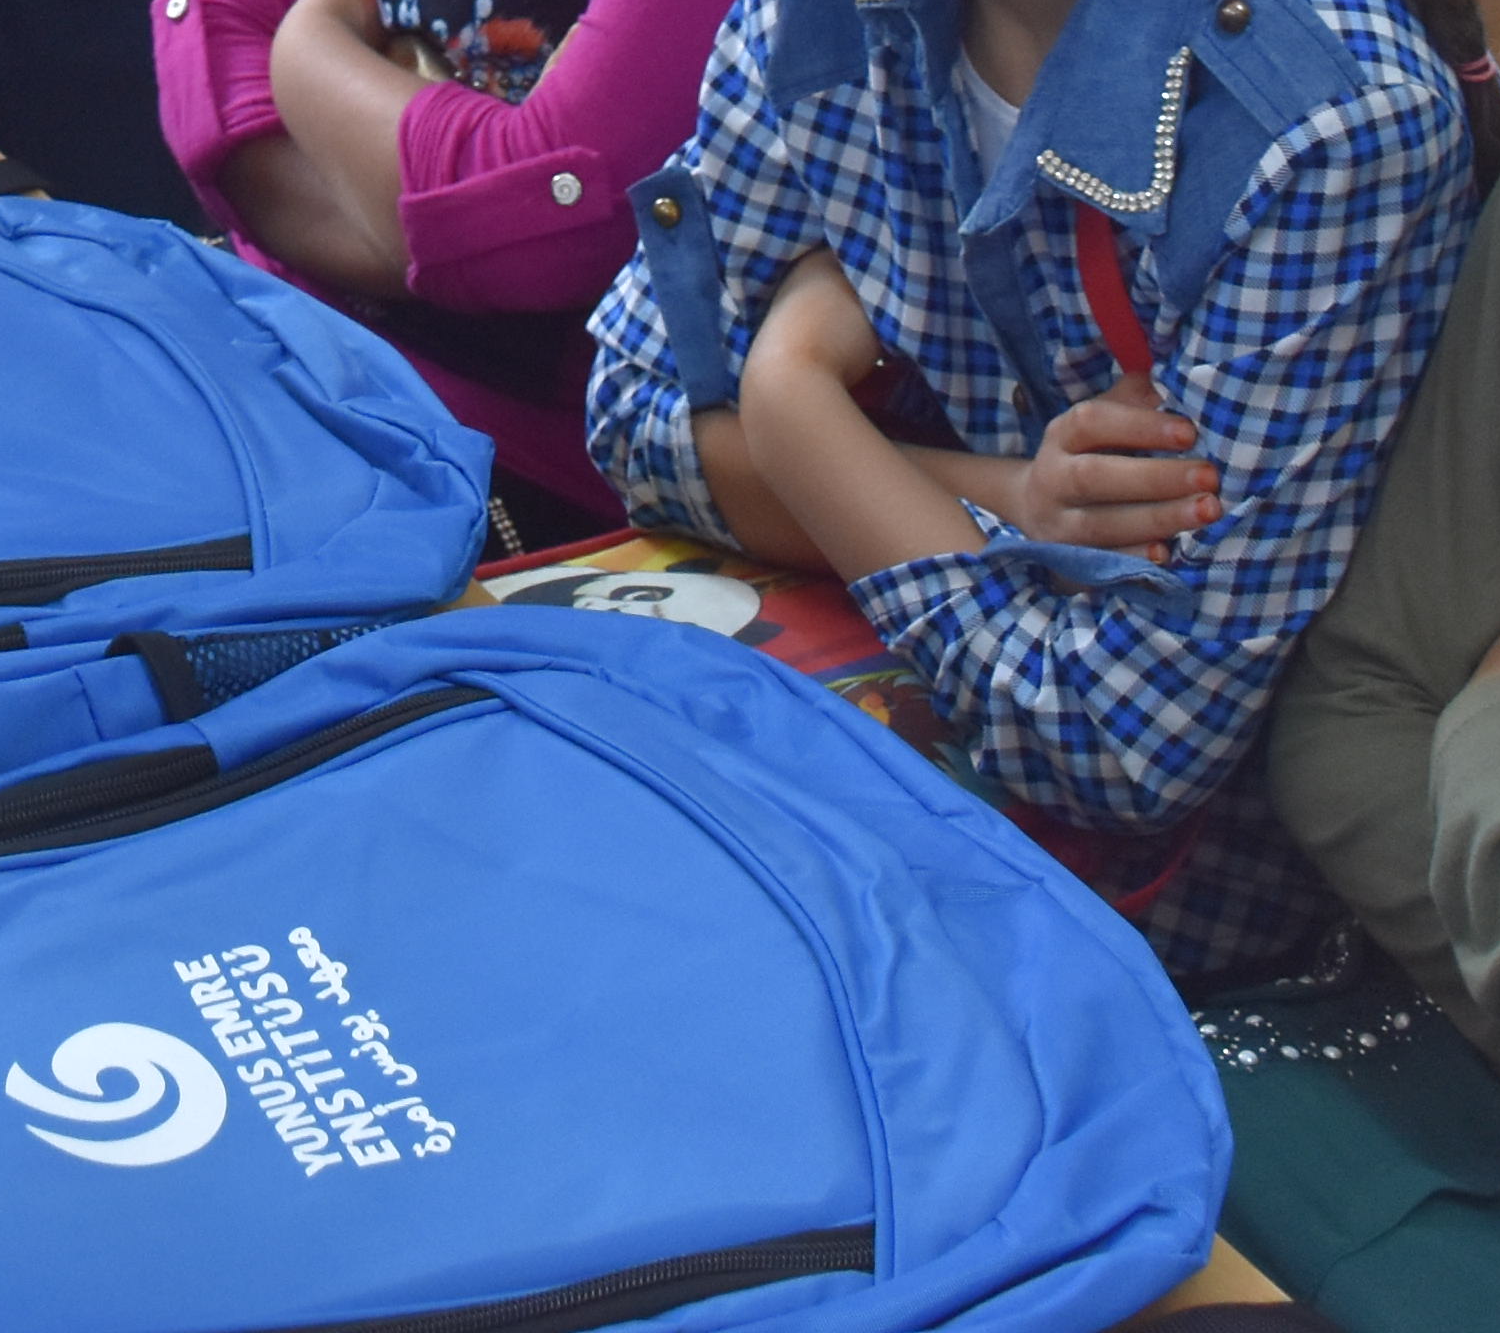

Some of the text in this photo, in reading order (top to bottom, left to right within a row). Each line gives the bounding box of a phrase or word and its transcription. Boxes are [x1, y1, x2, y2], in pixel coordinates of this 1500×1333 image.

[173, 954, 343, 1177] YUNUS EMRE
[221, 945, 401, 1167] ENSTİTÜSÜ
[288, 926, 351, 1005] معهد
[341, 1009, 418, 1086] يونس
